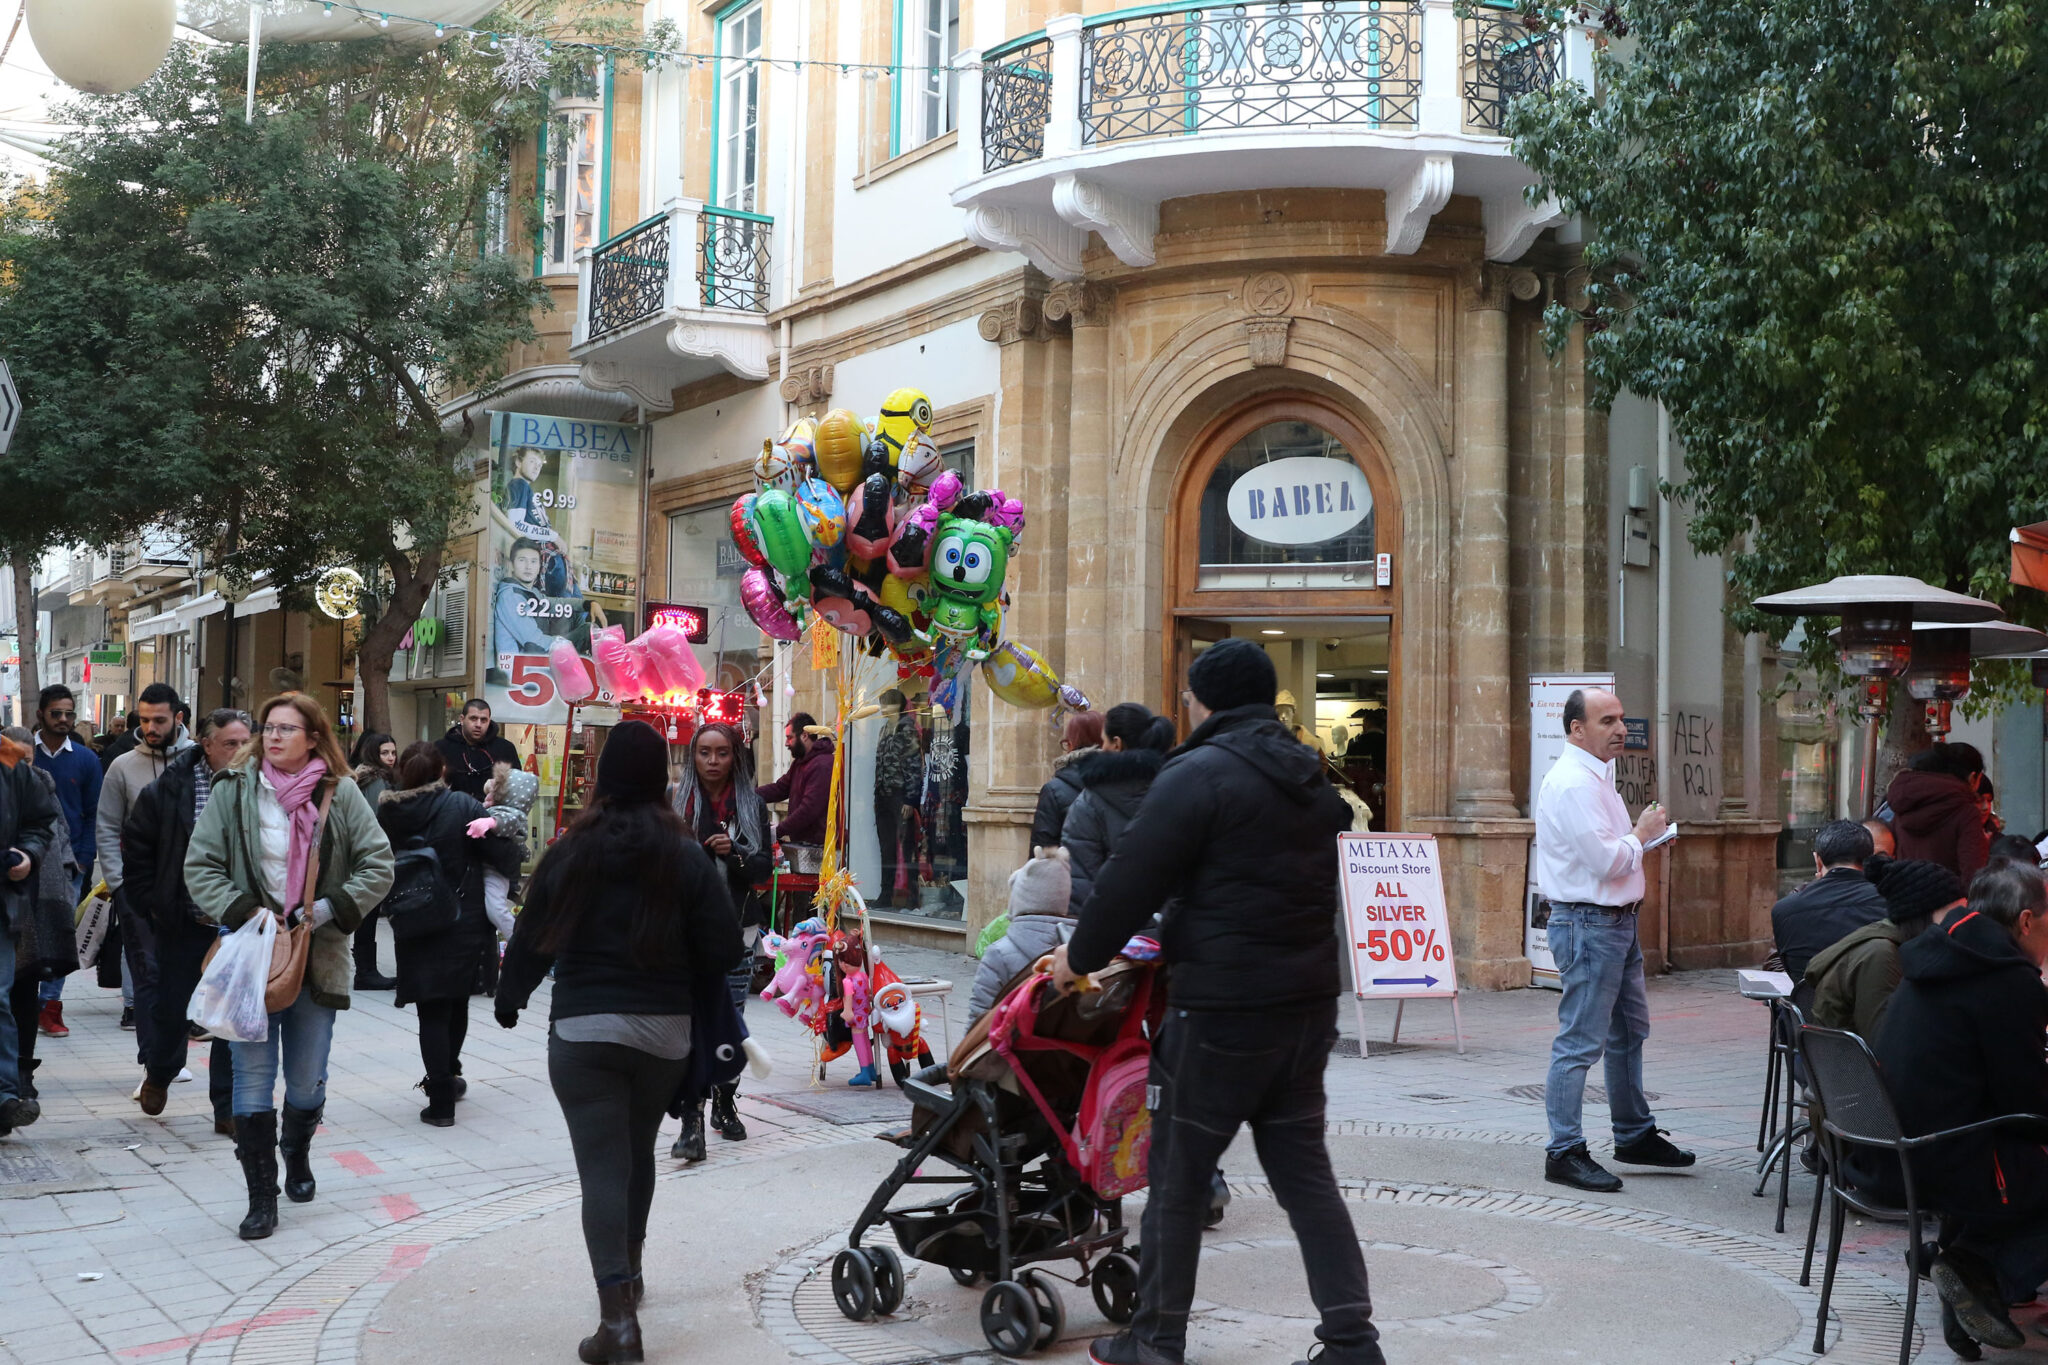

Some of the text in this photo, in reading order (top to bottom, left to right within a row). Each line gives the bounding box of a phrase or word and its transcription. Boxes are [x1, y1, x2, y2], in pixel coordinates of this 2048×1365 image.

[567, 449, 631, 463] stores
[532, 489, 576, 509] €9.99
[516, 597, 573, 618] €22.99
[1674, 711, 1714, 756] AEK
[1348, 841, 1428, 858] METAXA
[1350, 863, 1431, 874] Discount Store
[1374, 882, 1408, 897] ALL
[1366, 905, 1427, 922] SILVER
[1356, 929, 1445, 962] -50%
